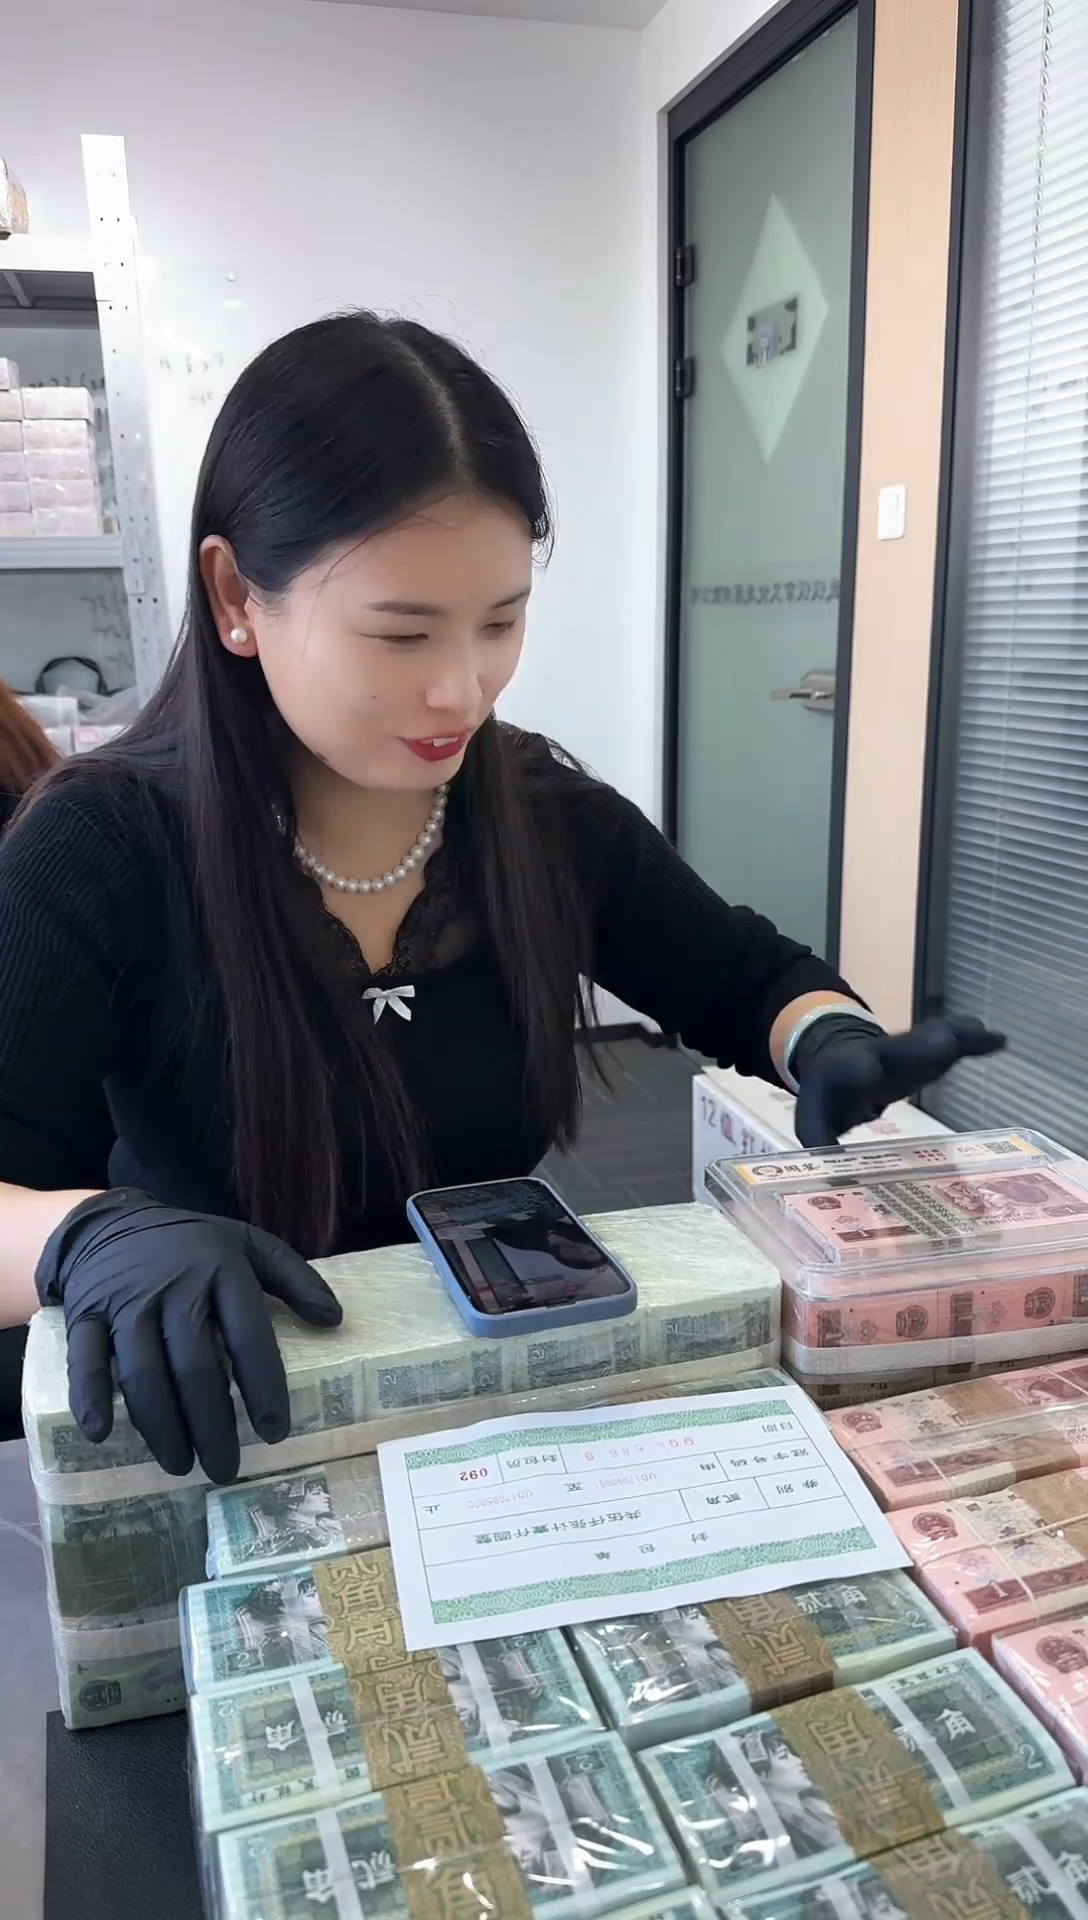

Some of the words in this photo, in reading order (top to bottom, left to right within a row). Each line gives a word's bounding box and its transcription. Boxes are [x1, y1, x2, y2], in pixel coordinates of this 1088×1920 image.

[384, 1374, 397, 1386] 2
[330, 1401, 347, 1415] 2
[459, 1467, 489, 1482] 092
[991, 1580, 1009, 1598] 1
[795, 1584, 868, 1614] 贰角
[903, 1609, 926, 1629] 2
[511, 1635, 528, 1648] 2
[236, 1651, 250, 1668] 2
[217, 1698, 236, 1718] 2
[576, 1754, 594, 1771] 2
[1019, 1744, 1043, 1770] 2
